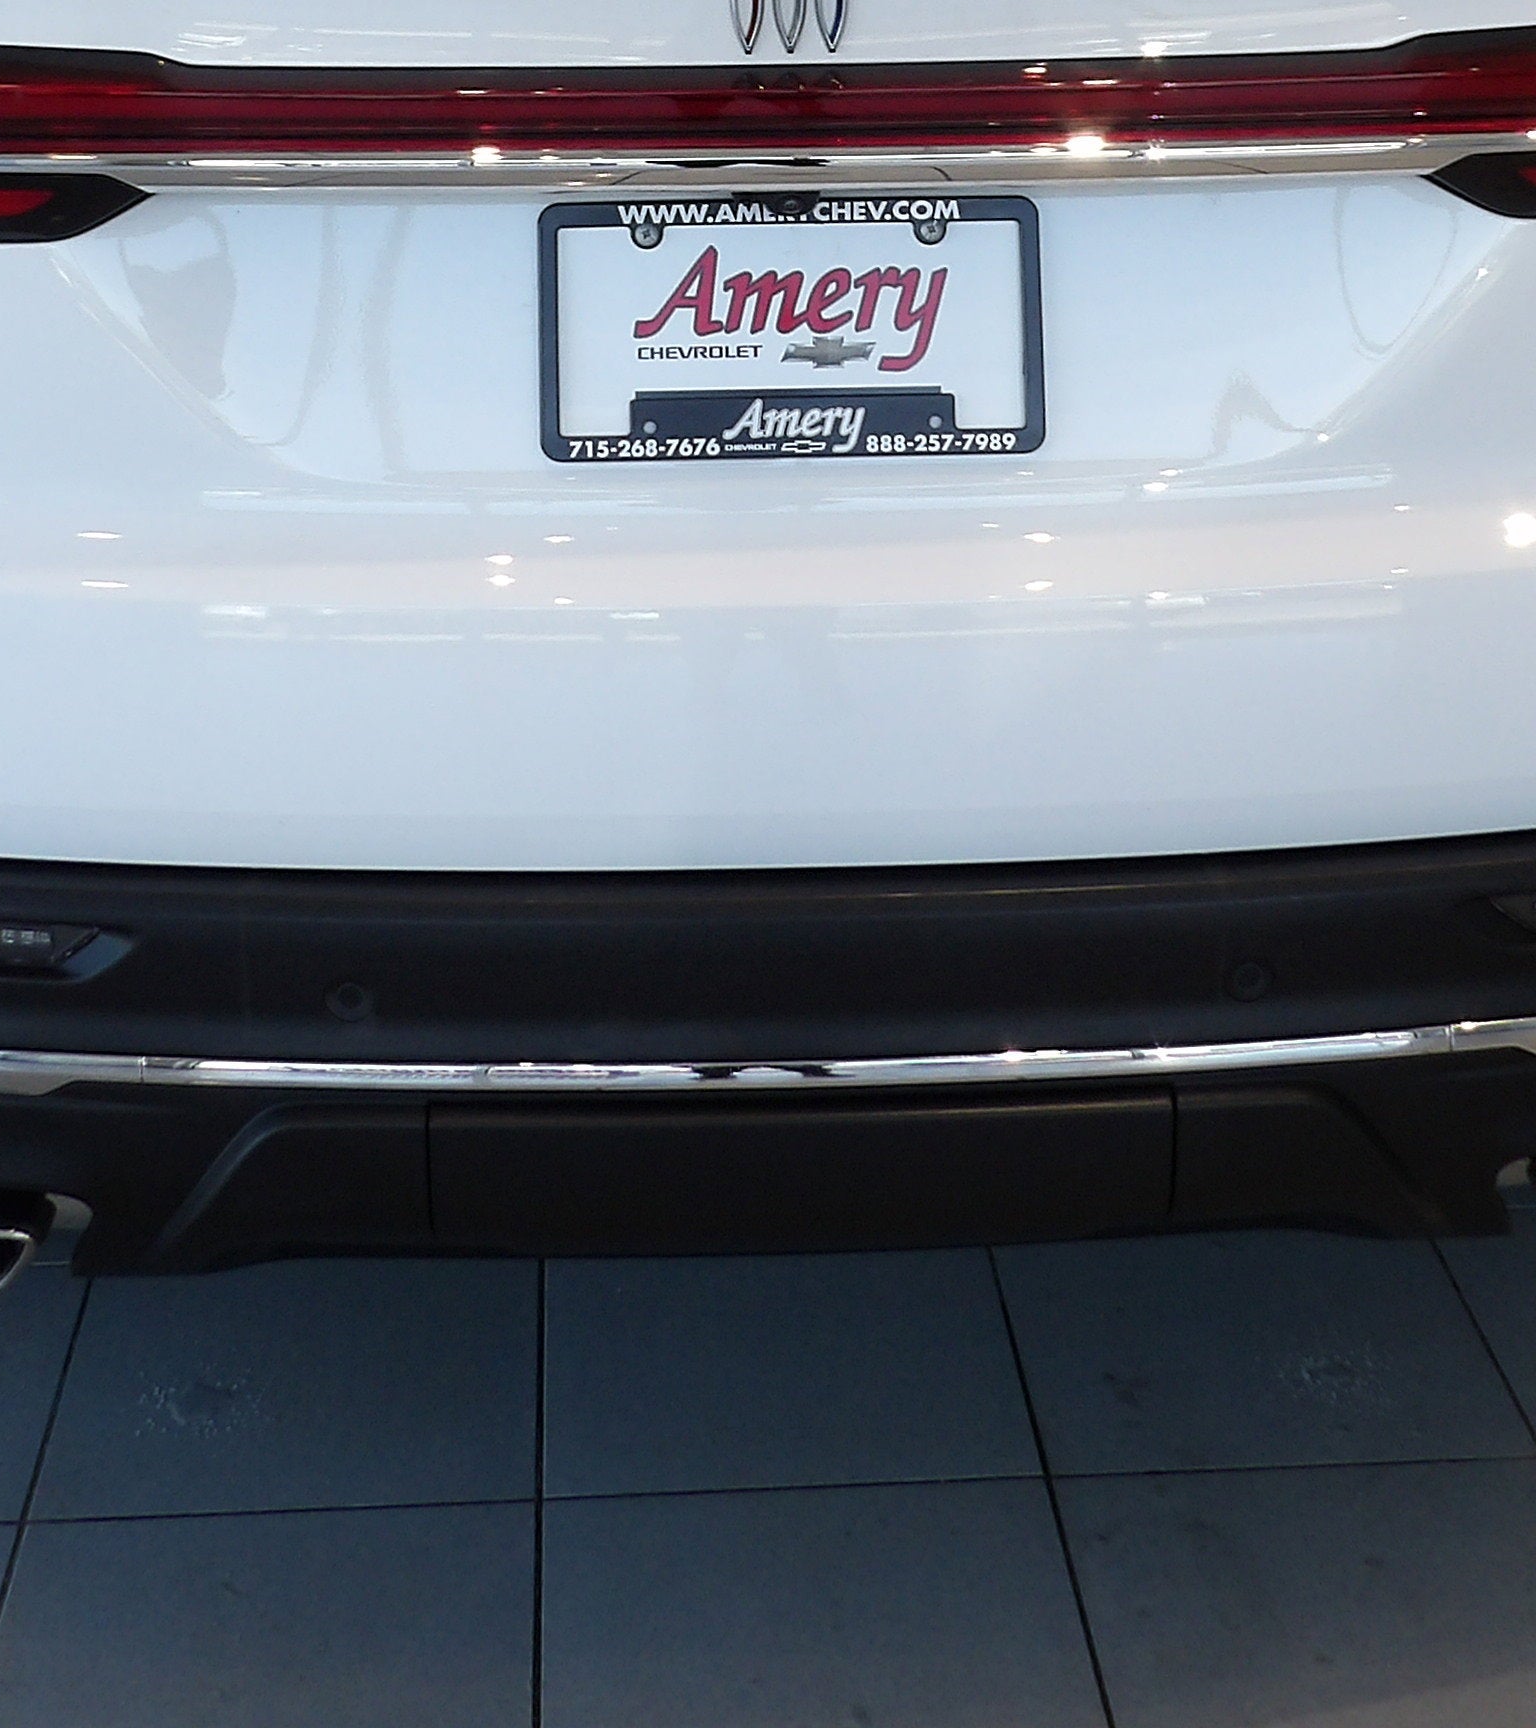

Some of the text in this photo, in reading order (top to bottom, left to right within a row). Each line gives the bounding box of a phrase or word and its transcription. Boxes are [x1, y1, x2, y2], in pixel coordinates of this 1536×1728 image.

[632, 244, 949, 373] Amery
[637, 344, 764, 361] CHEVROLET
[721, 398, 866, 453] Amery
[569, 437, 721, 459] 715-268-7676
[724, 442, 778, 452] CHEVROLET
[865, 432, 1016, 453] 888-257-7989
